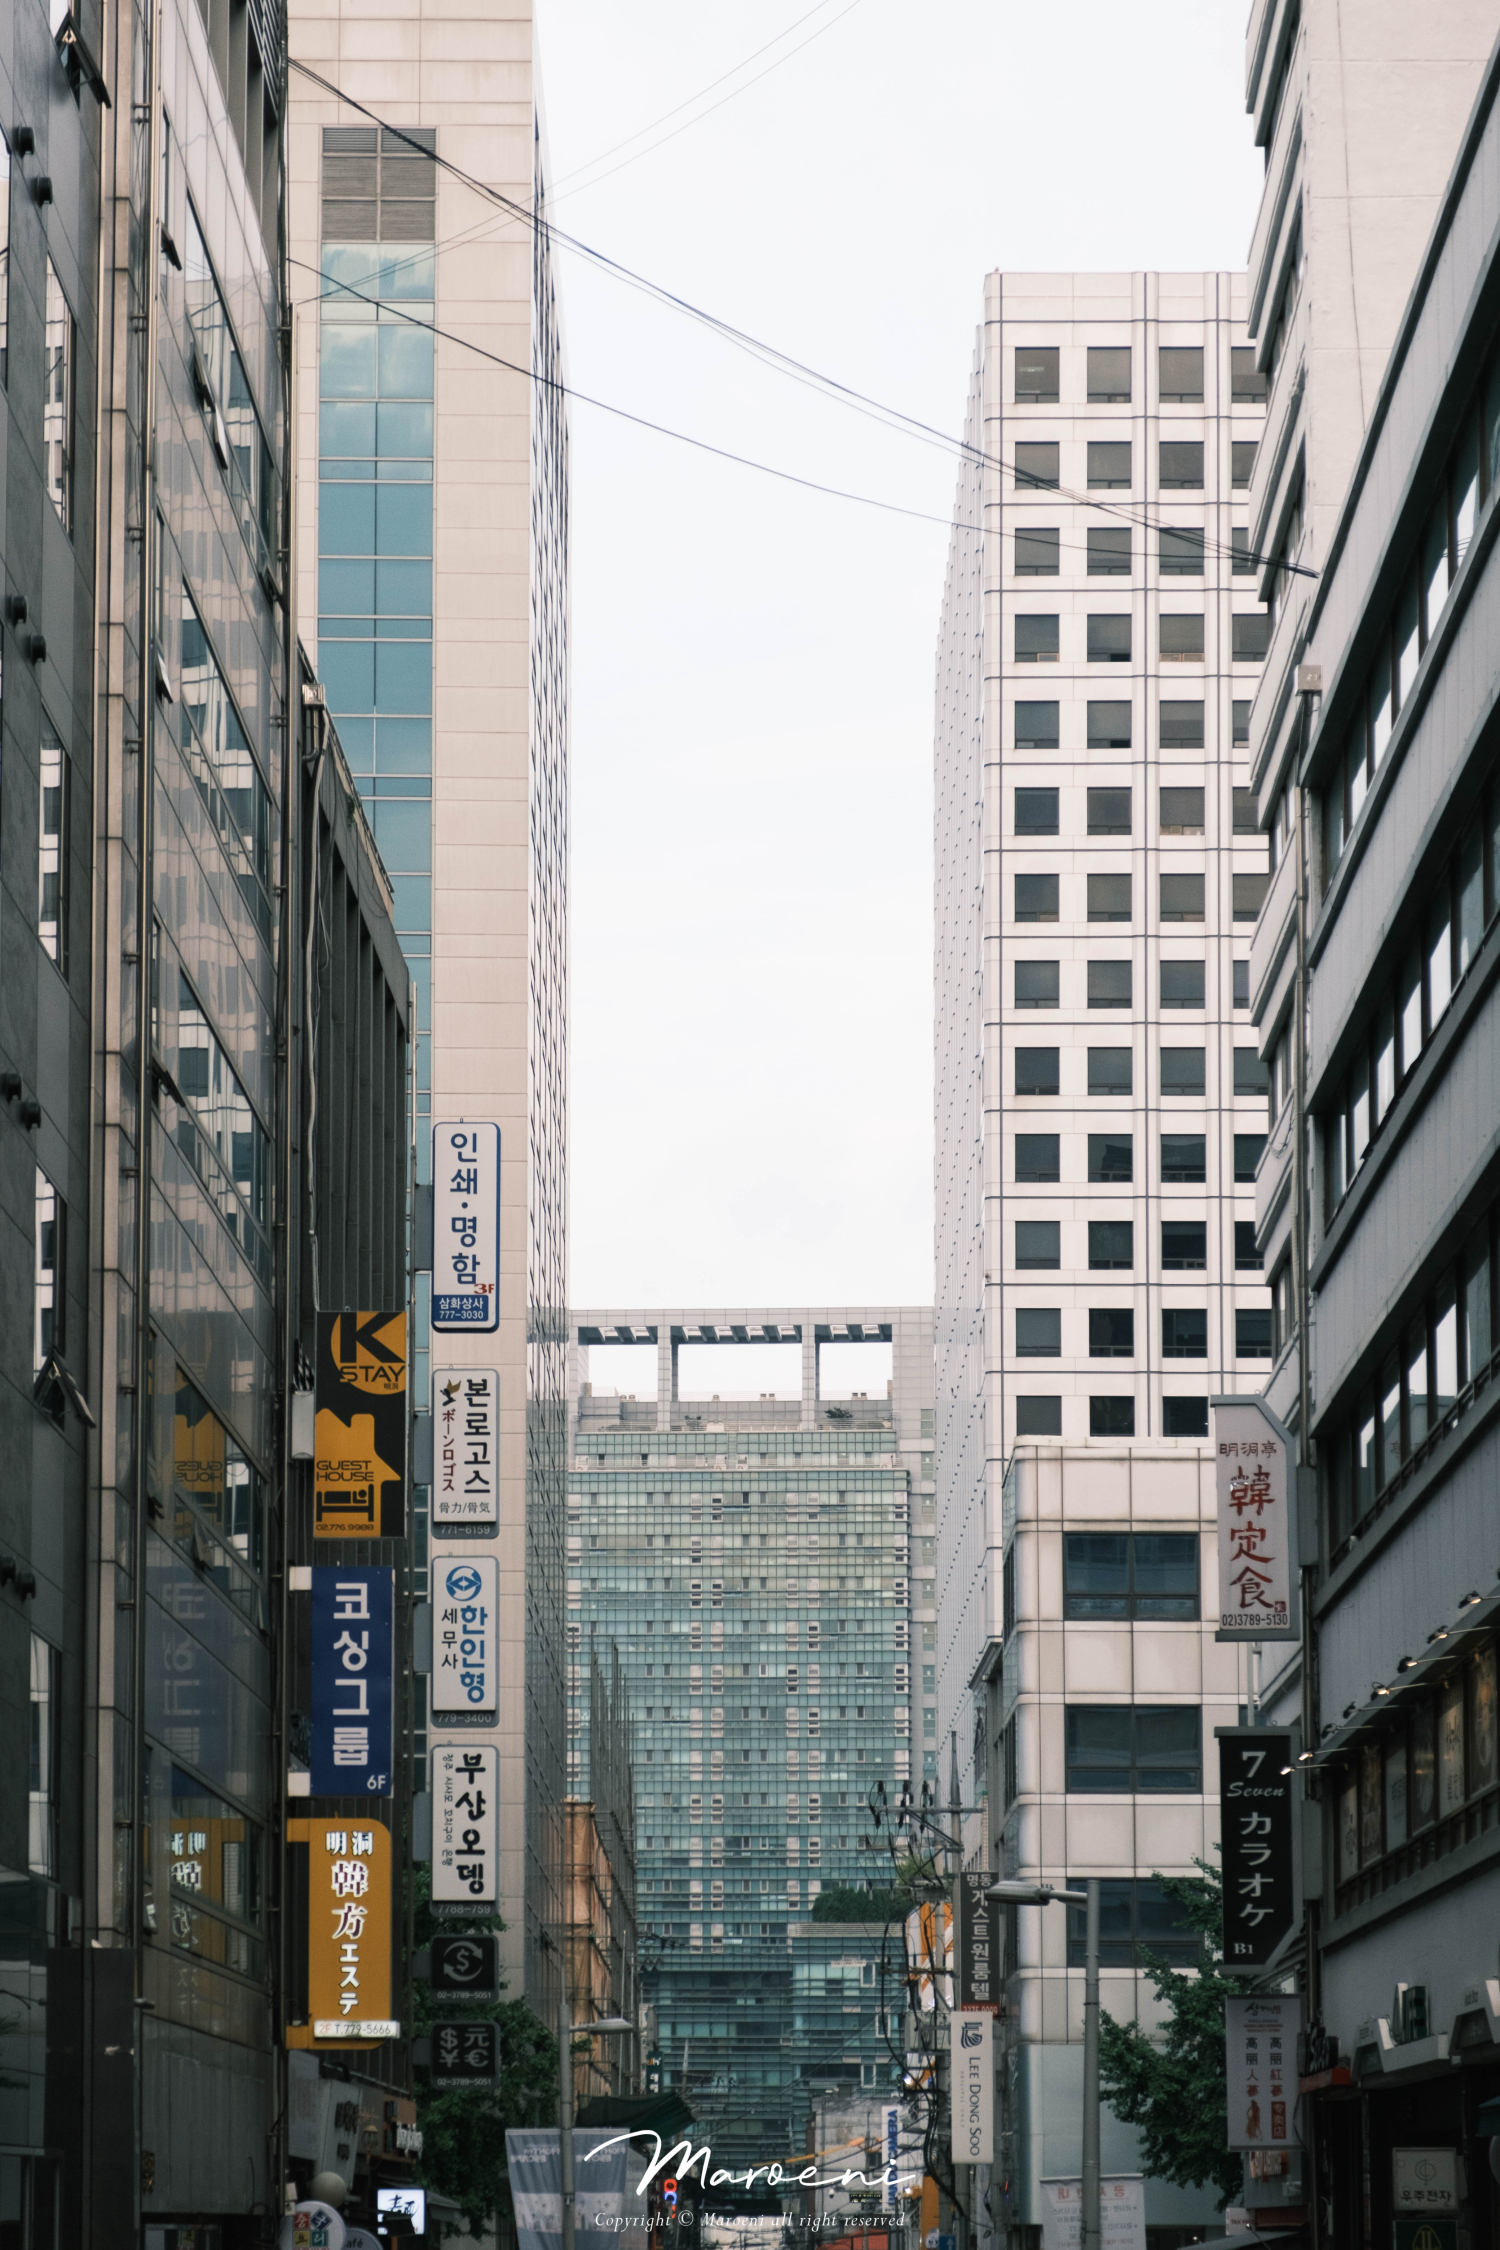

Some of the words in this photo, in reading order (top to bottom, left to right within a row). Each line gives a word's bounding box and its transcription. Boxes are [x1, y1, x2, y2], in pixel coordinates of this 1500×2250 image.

[450, 1133, 480, 1285] 인쇄·명함
[473, 1283, 495, 1294] 3F
[438, 1297, 484, 1310] 삼화상사
[439, 1310, 484, 1319] 777-3030
[340, 1312, 406, 1363] K
[340, 1366, 406, 1383] STAY
[464, 1378, 491, 1494] 본로고스
[442, 1408, 455, 1492] ボーンロゴス
[316, 1460, 372, 1470] GUEST
[316, 1472, 374, 1482] HOUSE
[440, 1525, 490, 1534] 771-6159
[1229, 1464, 1276, 1609] 韓定食
[1222, 1614, 1288, 1627] 02)3789-5130
[441, 1608, 458, 1670] 세무사
[460, 1605, 488, 1704] 한인형
[332, 1582, 370, 1766] 코싱그룹
[437, 1712, 492, 1724] 779-3400
[1241, 1750, 1267, 1779] 7
[366, 1776, 386, 1790] 6F
[1226, 1782, 1286, 1798] Seven
[455, 1753, 486, 1895] 부산오뎅
[326, 1831, 374, 1856] 明洞
[1237, 1811, 1275, 1928] カラオケ
[966, 1872, 992, 1888] 명동
[437, 1904, 491, 1914] 7788-759
[331, 1861, 369, 2016] 韓方エステ
[970, 1888, 991, 2001] 게스트원룸텔
[1233, 1942, 1254, 1955] B1
[437, 1991, 492, 2000] 02-3789-5051
[318, 2024, 331, 2034] 2F
[334, 2024, 391, 2034] T.779-5666
[968, 2056, 980, 2078] LEE
[437, 2078, 492, 2086] 02-3789-5051
[968, 2080, 980, 2122] DONG
[888, 2110, 898, 2158] CAMERA
[968, 2126, 980, 2157] SOO
[1400, 2190, 1452, 2202] 우주전자
